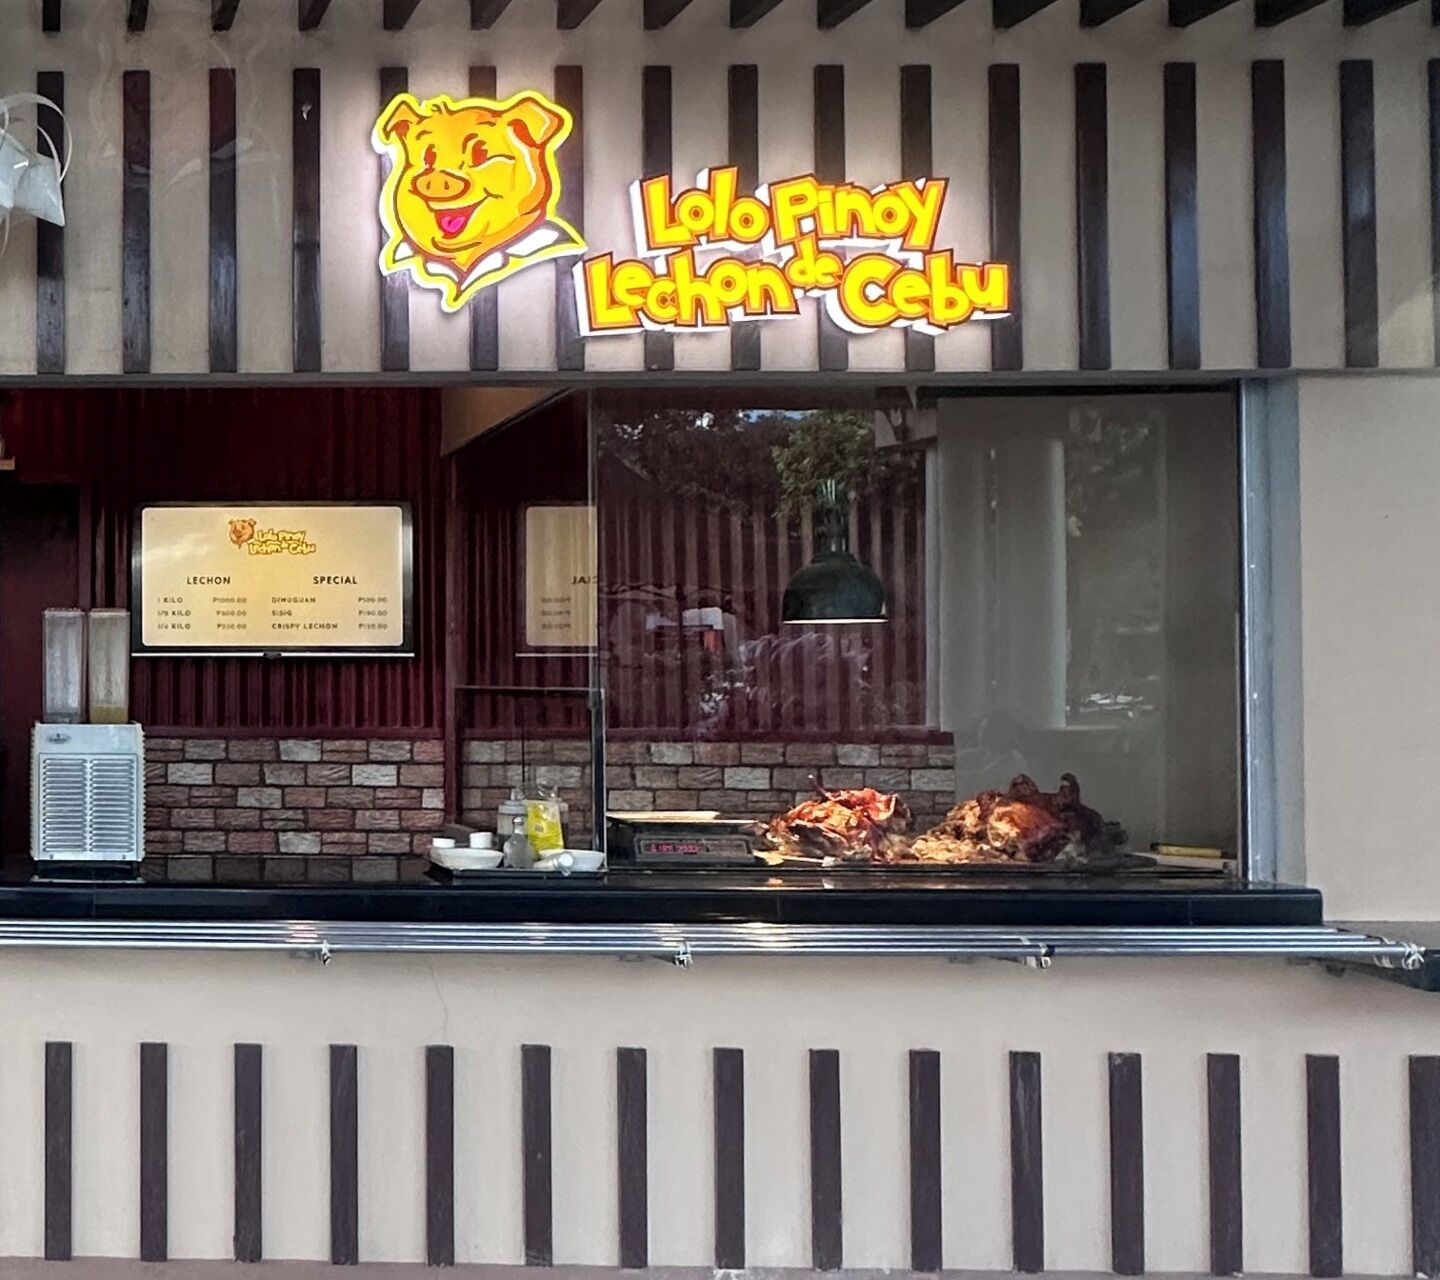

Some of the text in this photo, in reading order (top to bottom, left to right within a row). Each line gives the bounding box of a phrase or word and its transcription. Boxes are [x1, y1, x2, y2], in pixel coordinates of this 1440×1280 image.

[641, 166, 950, 251] Lolo Pinoy
[585, 238, 1010, 332] Lechon de Cebu
[186, 576, 231, 585] LECHON
[313, 576, 358, 585] SPECIAL
[271, 609, 293, 617] SISIG
